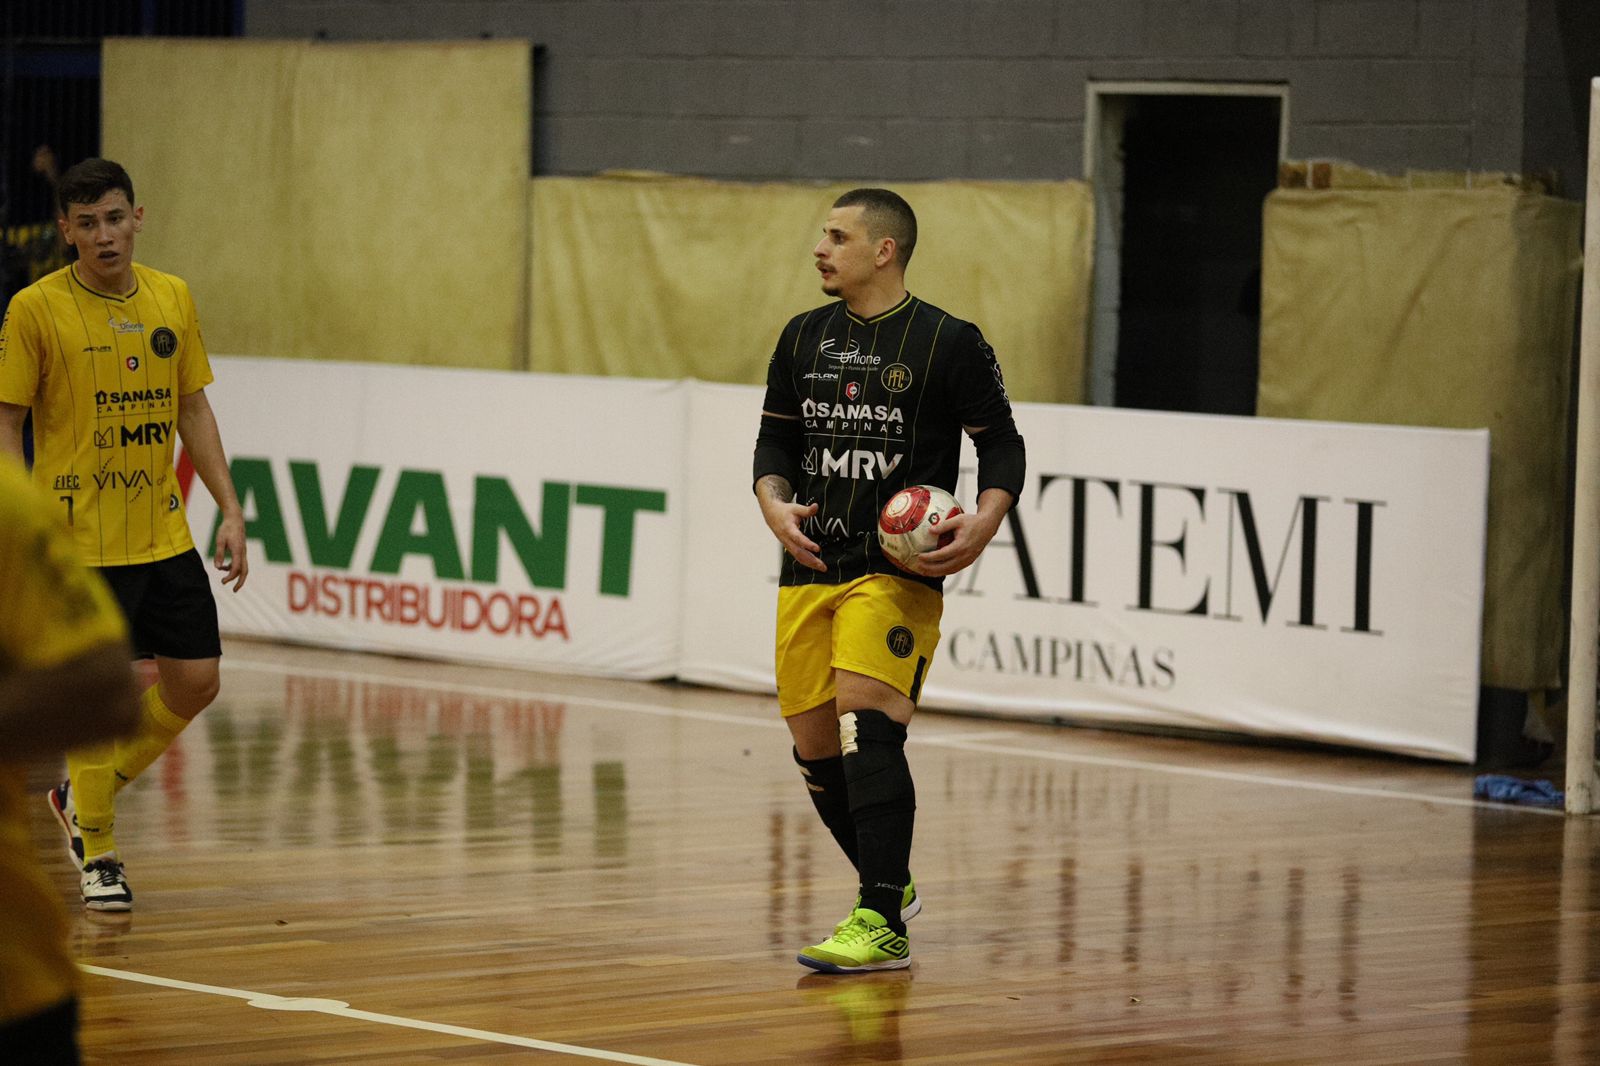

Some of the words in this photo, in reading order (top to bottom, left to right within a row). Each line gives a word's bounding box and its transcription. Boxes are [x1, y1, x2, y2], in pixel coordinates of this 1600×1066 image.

[840, 351, 881, 365] Unione
[110, 388, 172, 403] SANASA
[97, 401, 172, 413] CAMPINAS
[816, 402, 904, 423] SANASA
[120, 420, 173, 447] MRV
[805, 420, 903, 435] CAMPINAS
[821, 448, 904, 480] MRV
[54, 474, 80, 489] FIEC
[93, 469, 152, 490] VIVA
[207, 455, 667, 597] AVANT
[944, 468, 1388, 637] ATEMI
[286, 571, 571, 641] DISTRIBUIDORA
[948, 626, 1177, 690] CAMPINAS
